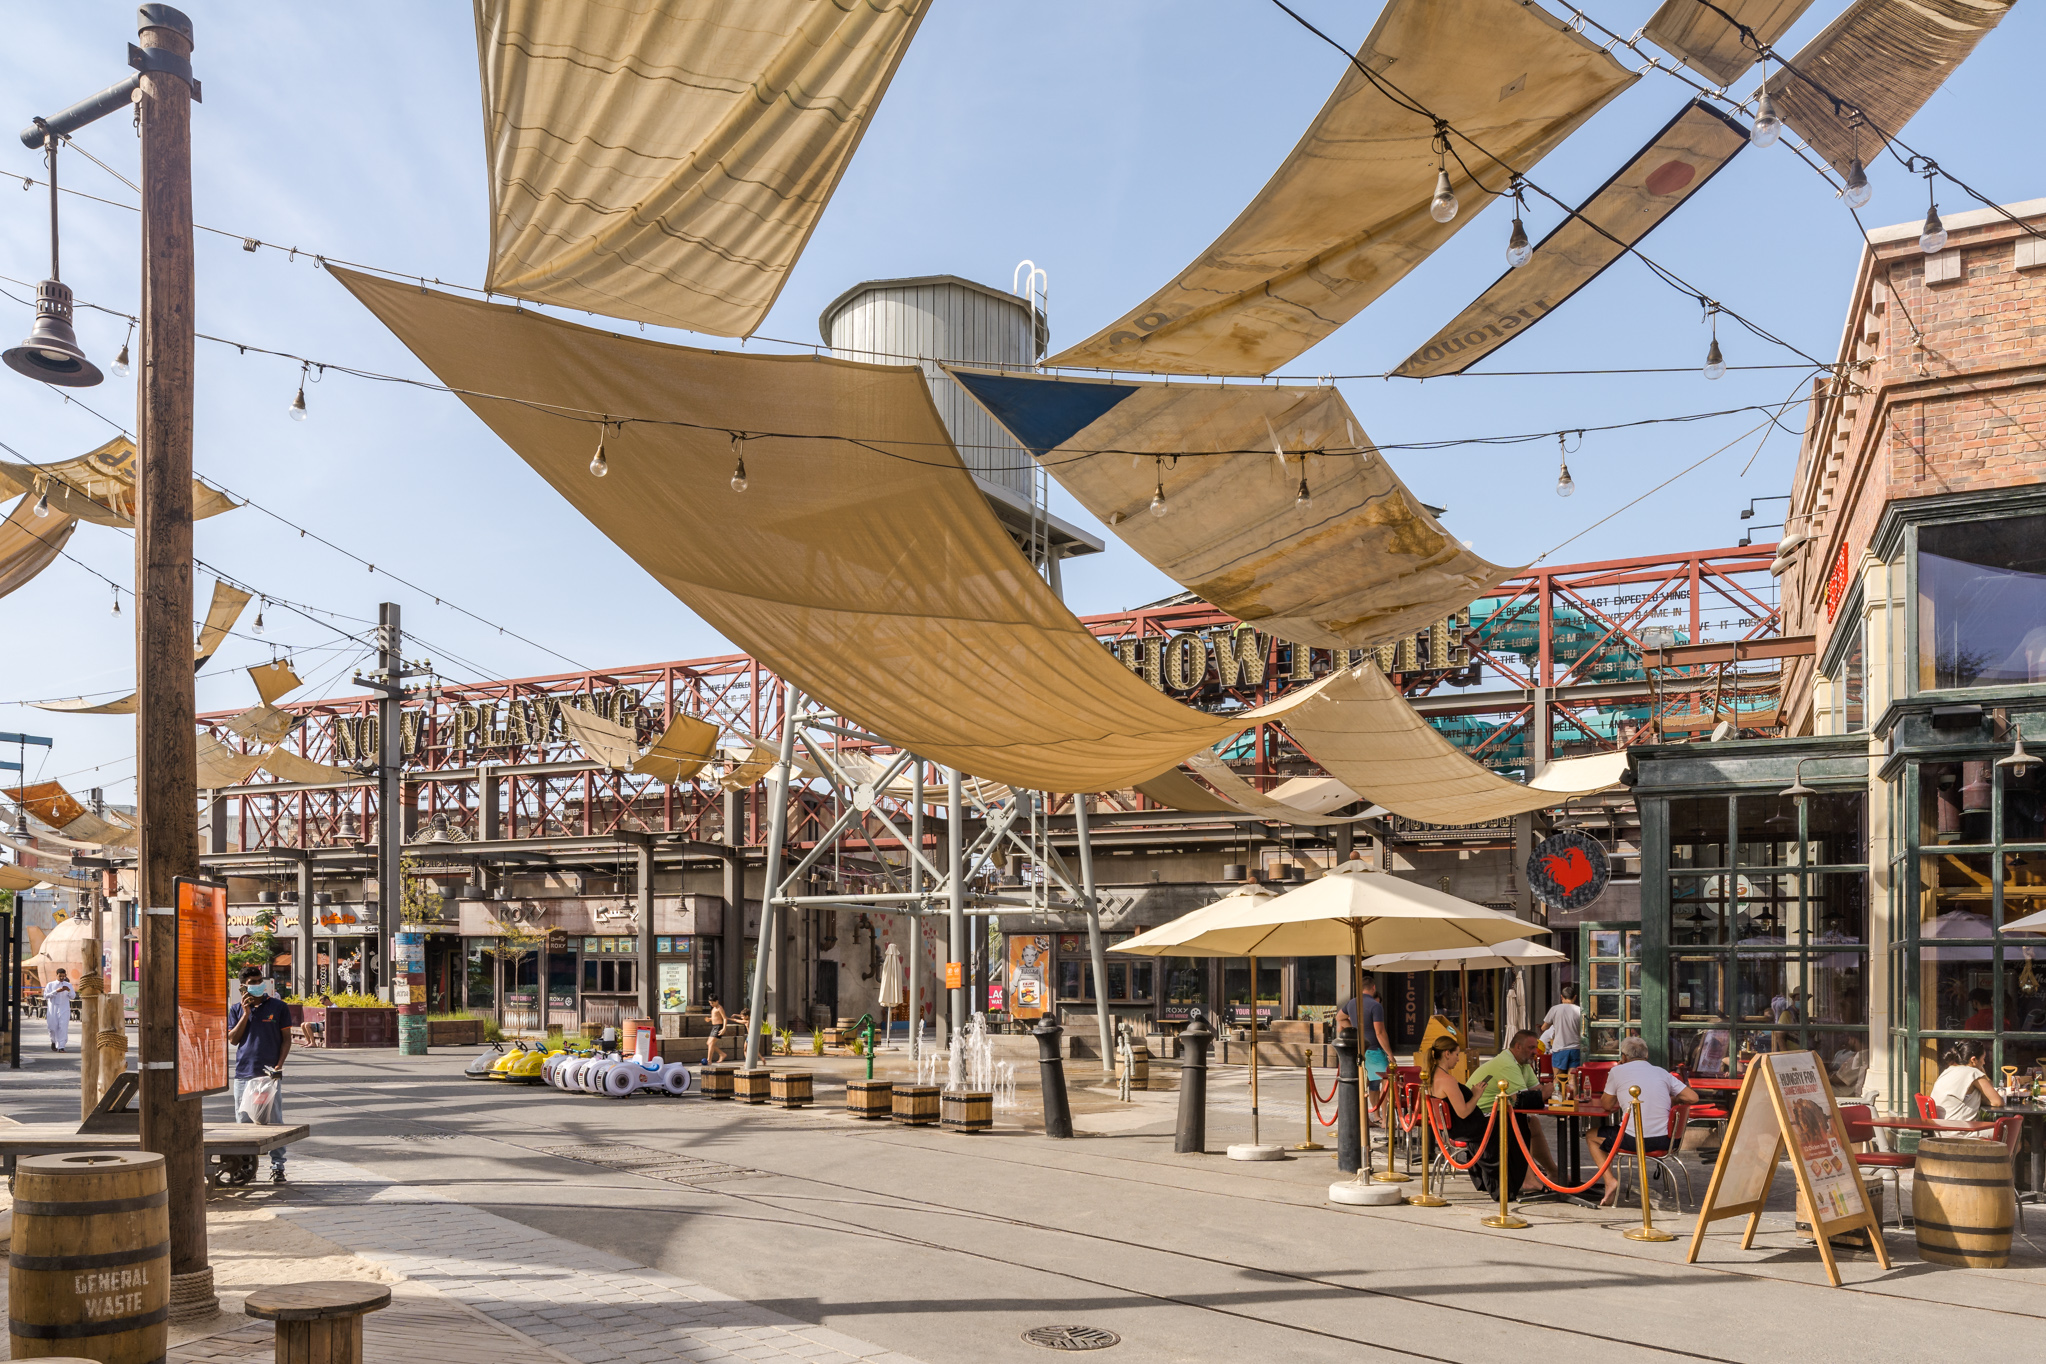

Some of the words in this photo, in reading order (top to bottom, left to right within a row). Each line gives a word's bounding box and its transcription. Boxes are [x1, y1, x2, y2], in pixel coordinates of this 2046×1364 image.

[1580, 597, 1608, 609] LEAST
[1614, 592, 1658, 605] EXPECTED
[1672, 607, 1682, 617] IN
[1500, 655, 1516, 664] THE
[1599, 645, 1625, 656] FIGHT
[1594, 662, 1618, 673] FIRST
[334, 709, 425, 760] NOW
[498, 906, 547, 922] ROXY
[1235, 1008, 1250, 1016] YOUR
[1405, 972, 1417, 1035] ELCOME
[1779, 1072, 1805, 1087] HUNGRY
[1804, 1070, 1817, 1084] FOR
[75, 1267, 149, 1295] GENERAL
[85, 1292, 143, 1318] WASTE
